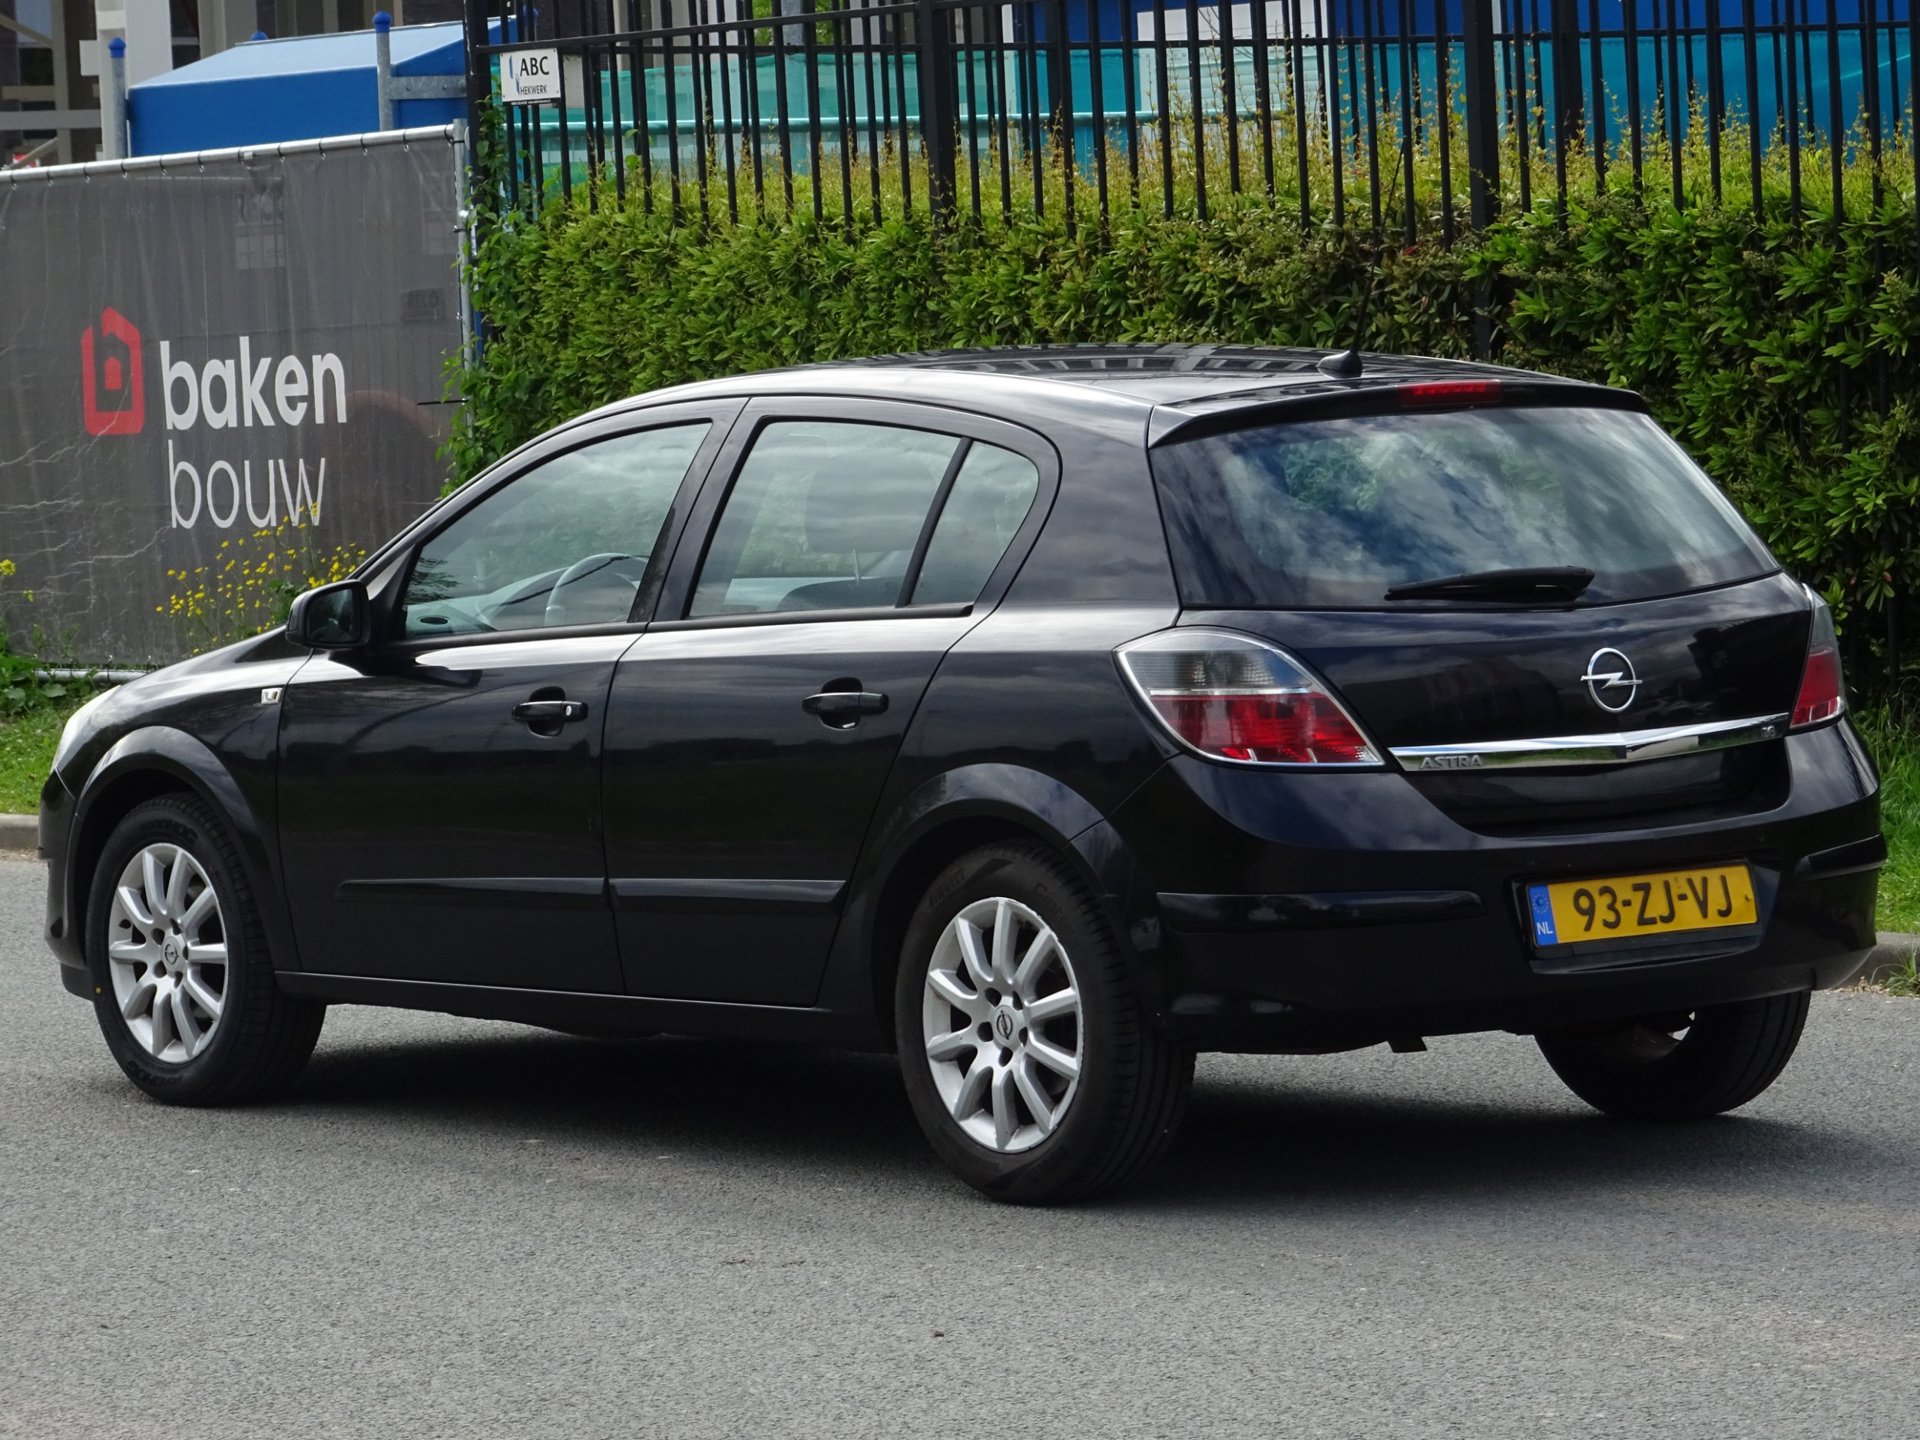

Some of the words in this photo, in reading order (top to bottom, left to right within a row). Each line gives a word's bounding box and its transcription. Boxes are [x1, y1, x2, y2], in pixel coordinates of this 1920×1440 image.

[519, 56, 550, 77] ABC
[520, 84, 548, 96] HEKWERK
[160, 336, 347, 431] baken
[168, 439, 326, 529] bouw
[1420, 754, 1483, 769] ASTRA
[1572, 874, 1733, 932] 93-ZJ-VJ
[1536, 921, 1554, 936] NL
